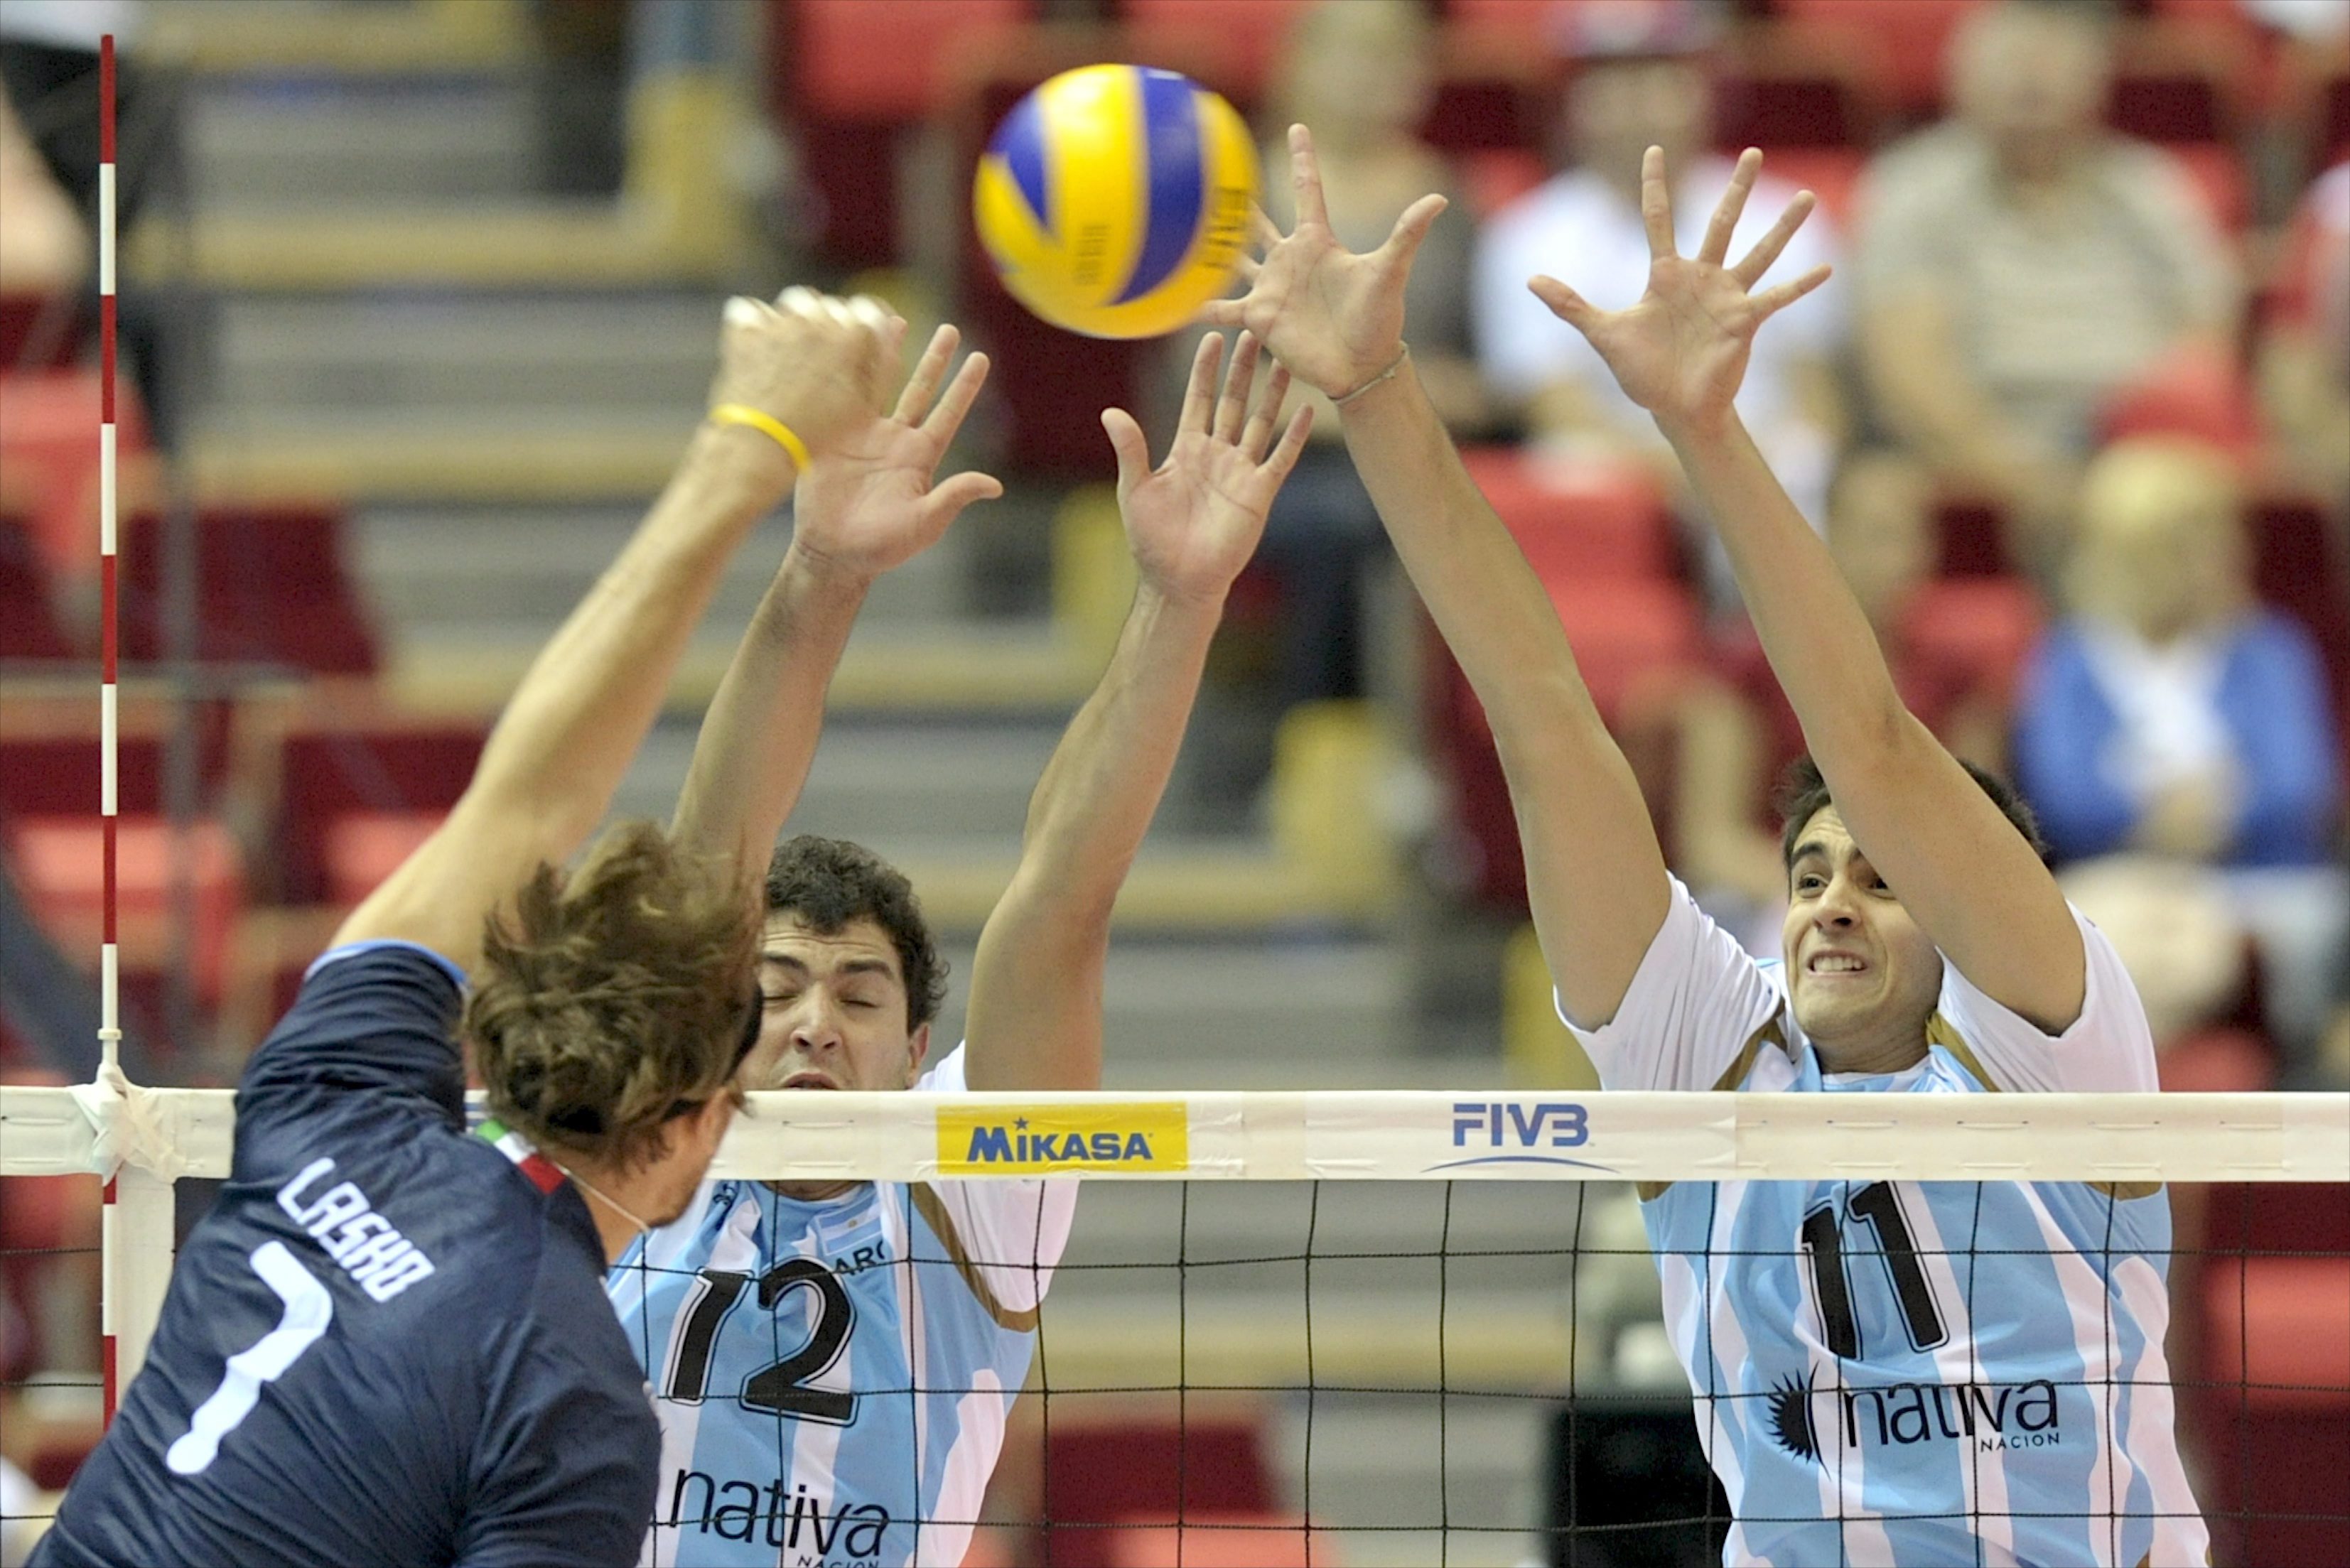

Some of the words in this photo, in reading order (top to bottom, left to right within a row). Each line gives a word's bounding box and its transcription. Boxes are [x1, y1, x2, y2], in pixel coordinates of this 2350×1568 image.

[967, 1117, 1153, 1162] MIKASA
[1453, 1103, 1588, 1147] FIVB
[276, 1157, 436, 1303] LASKO
[1801, 1181, 1949, 1361] 11
[666, 1254, 860, 1428] 12
[1844, 1380, 2058, 1447] nativa
[1980, 1432, 2059, 1452] NACION
[669, 1469, 888, 1558] nativa
